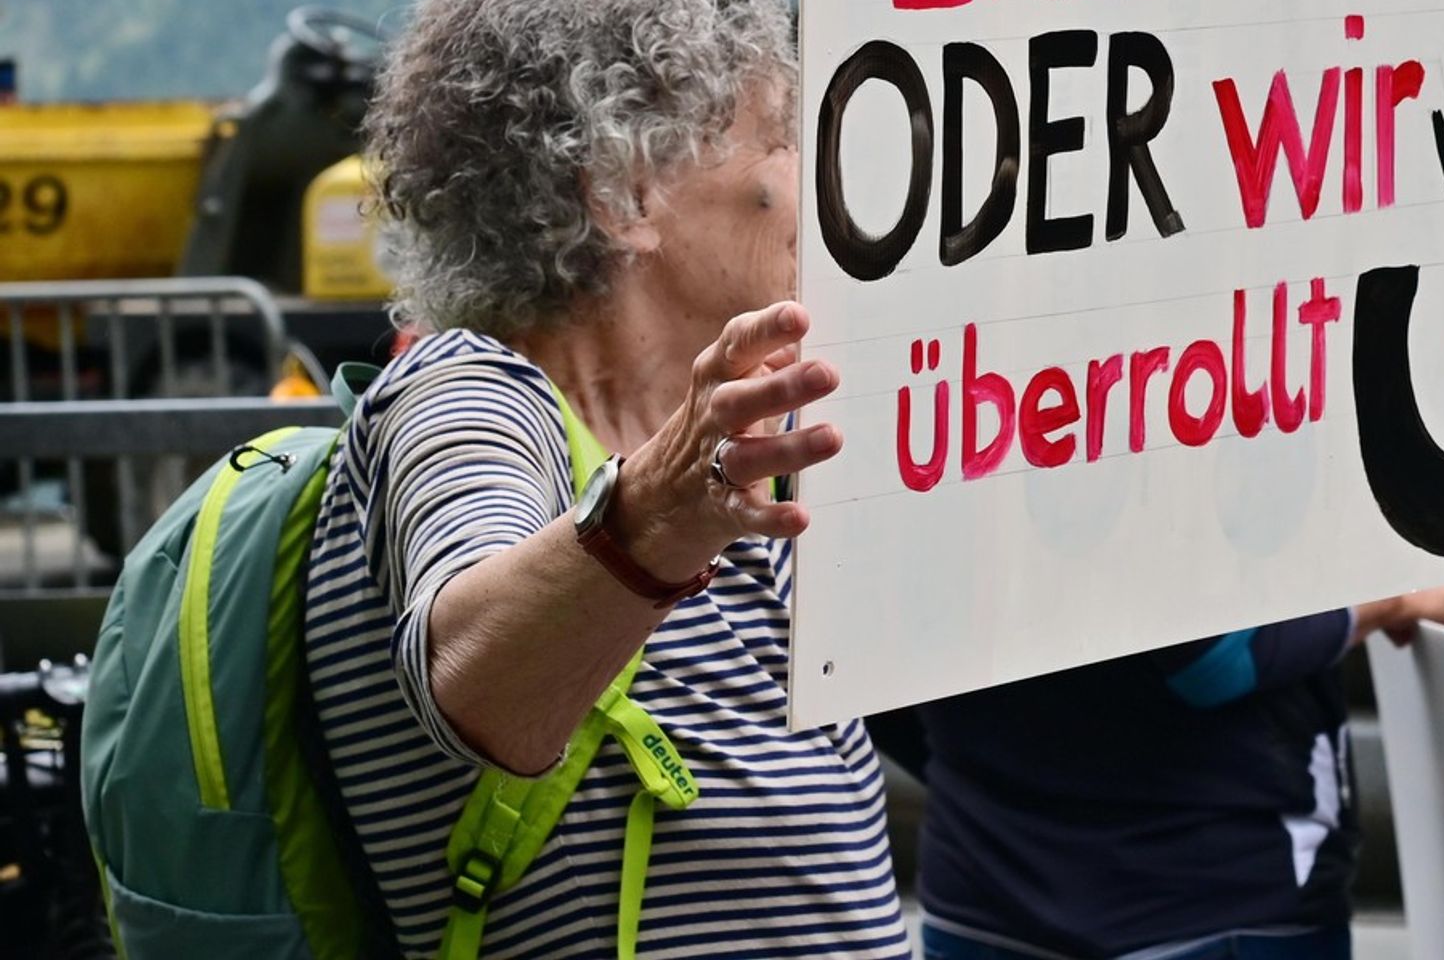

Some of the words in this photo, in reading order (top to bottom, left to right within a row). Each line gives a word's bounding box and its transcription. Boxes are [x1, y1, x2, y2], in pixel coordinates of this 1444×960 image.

[815, 29, 1186, 282] ODER
[1212, 14, 1425, 229] wir
[896, 277, 1341, 493] überrollt
[643, 734, 694, 795] deuter
